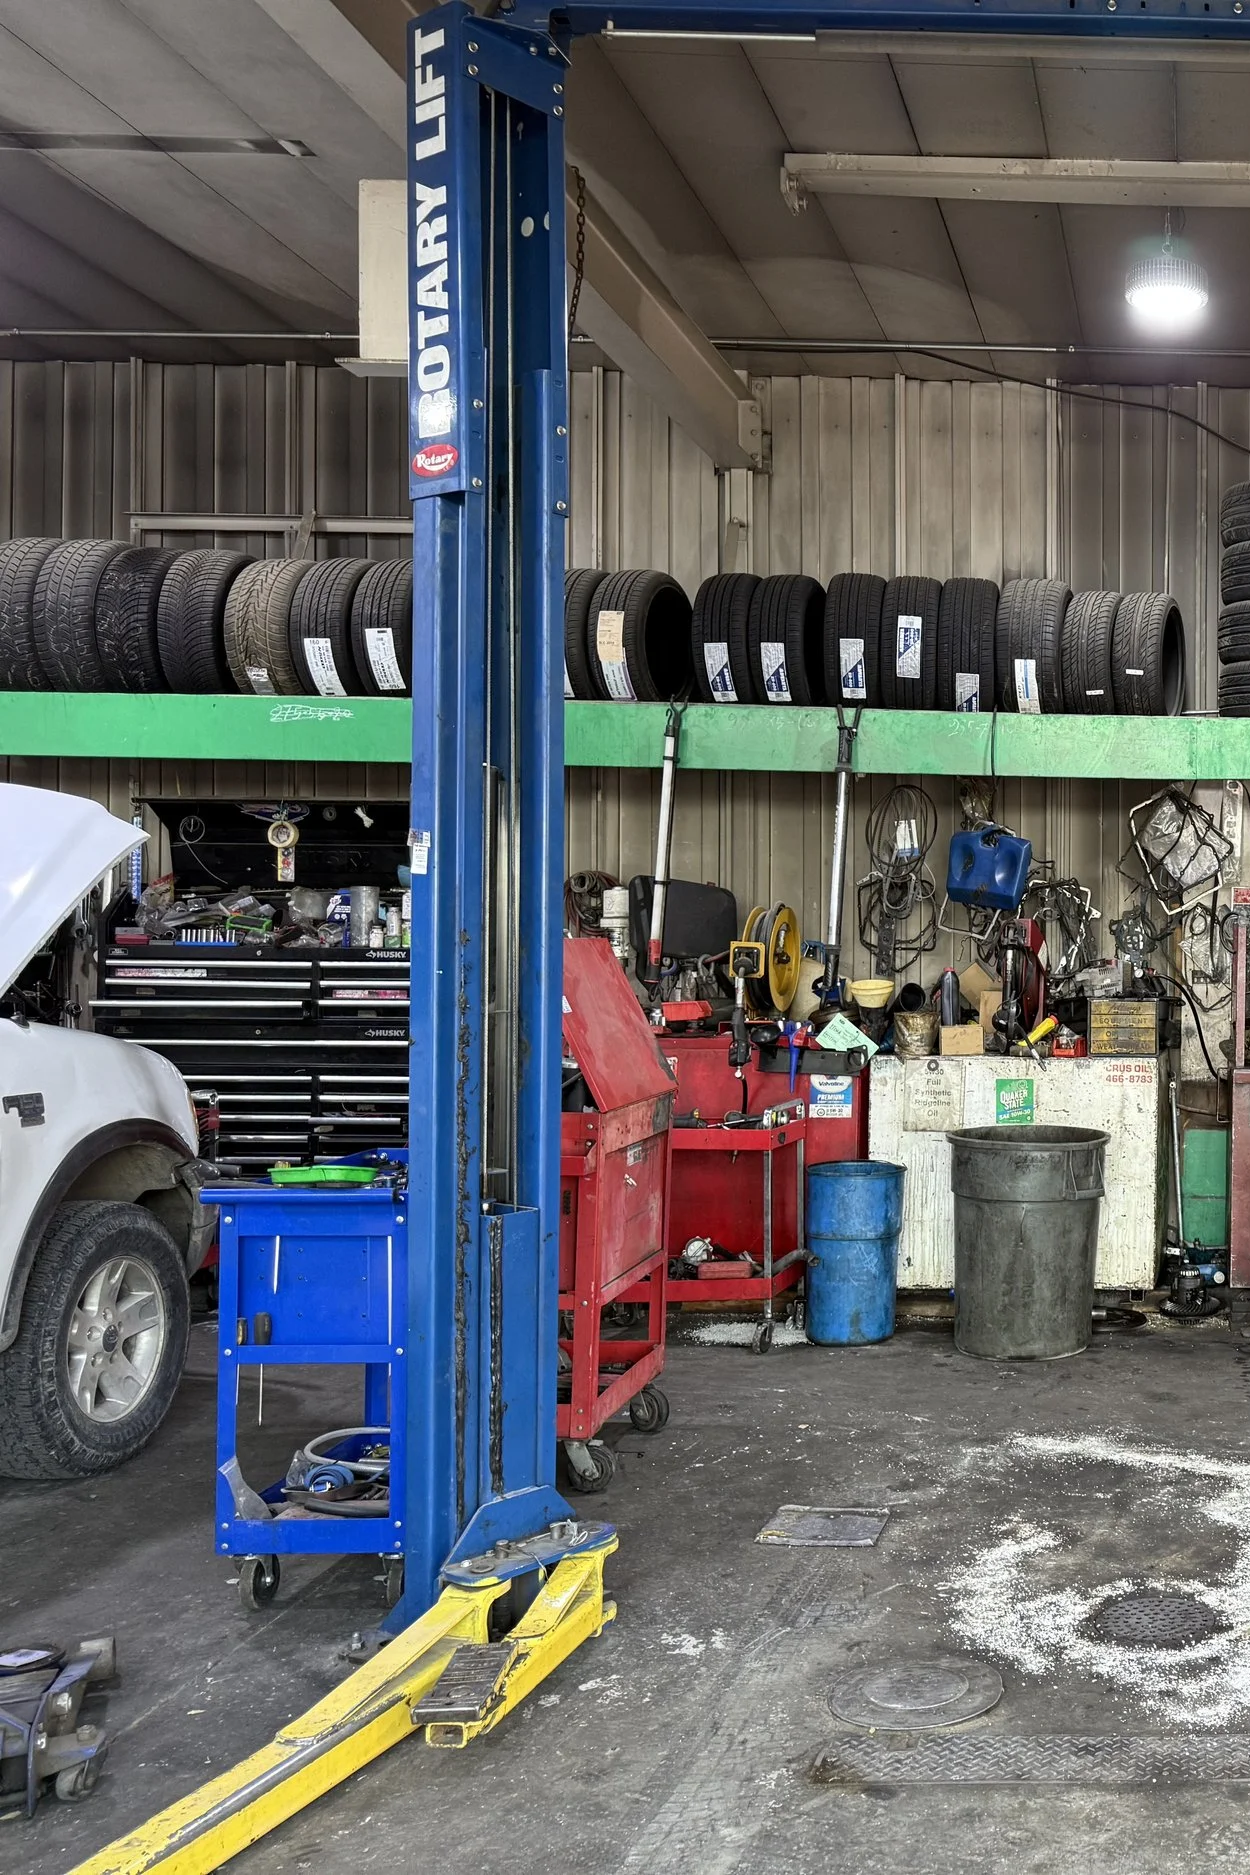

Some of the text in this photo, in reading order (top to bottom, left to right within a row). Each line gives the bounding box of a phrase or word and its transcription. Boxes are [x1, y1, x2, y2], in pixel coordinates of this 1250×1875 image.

[414, 28, 452, 439] ROTARY LIFT
[415, 453, 454, 471] Rotary
[376, 951, 407, 959] HUSKY
[375, 1029, 405, 1037] HUSKY
[1105, 1064, 1132, 1073] CRUS
[926, 1078, 941, 1086] Full
[1105, 1074, 1153, 1084] 466-8783
[914, 1089, 952, 1098] Synthetic
[1000, 1089, 1028, 1104] QUAKER
[914, 1099, 952, 1108] Ridgeline
[1004, 1099, 1025, 1111] STATE
[927, 1109, 938, 1117] Oil
[1011, 1109, 1031, 1119] 10W-30
